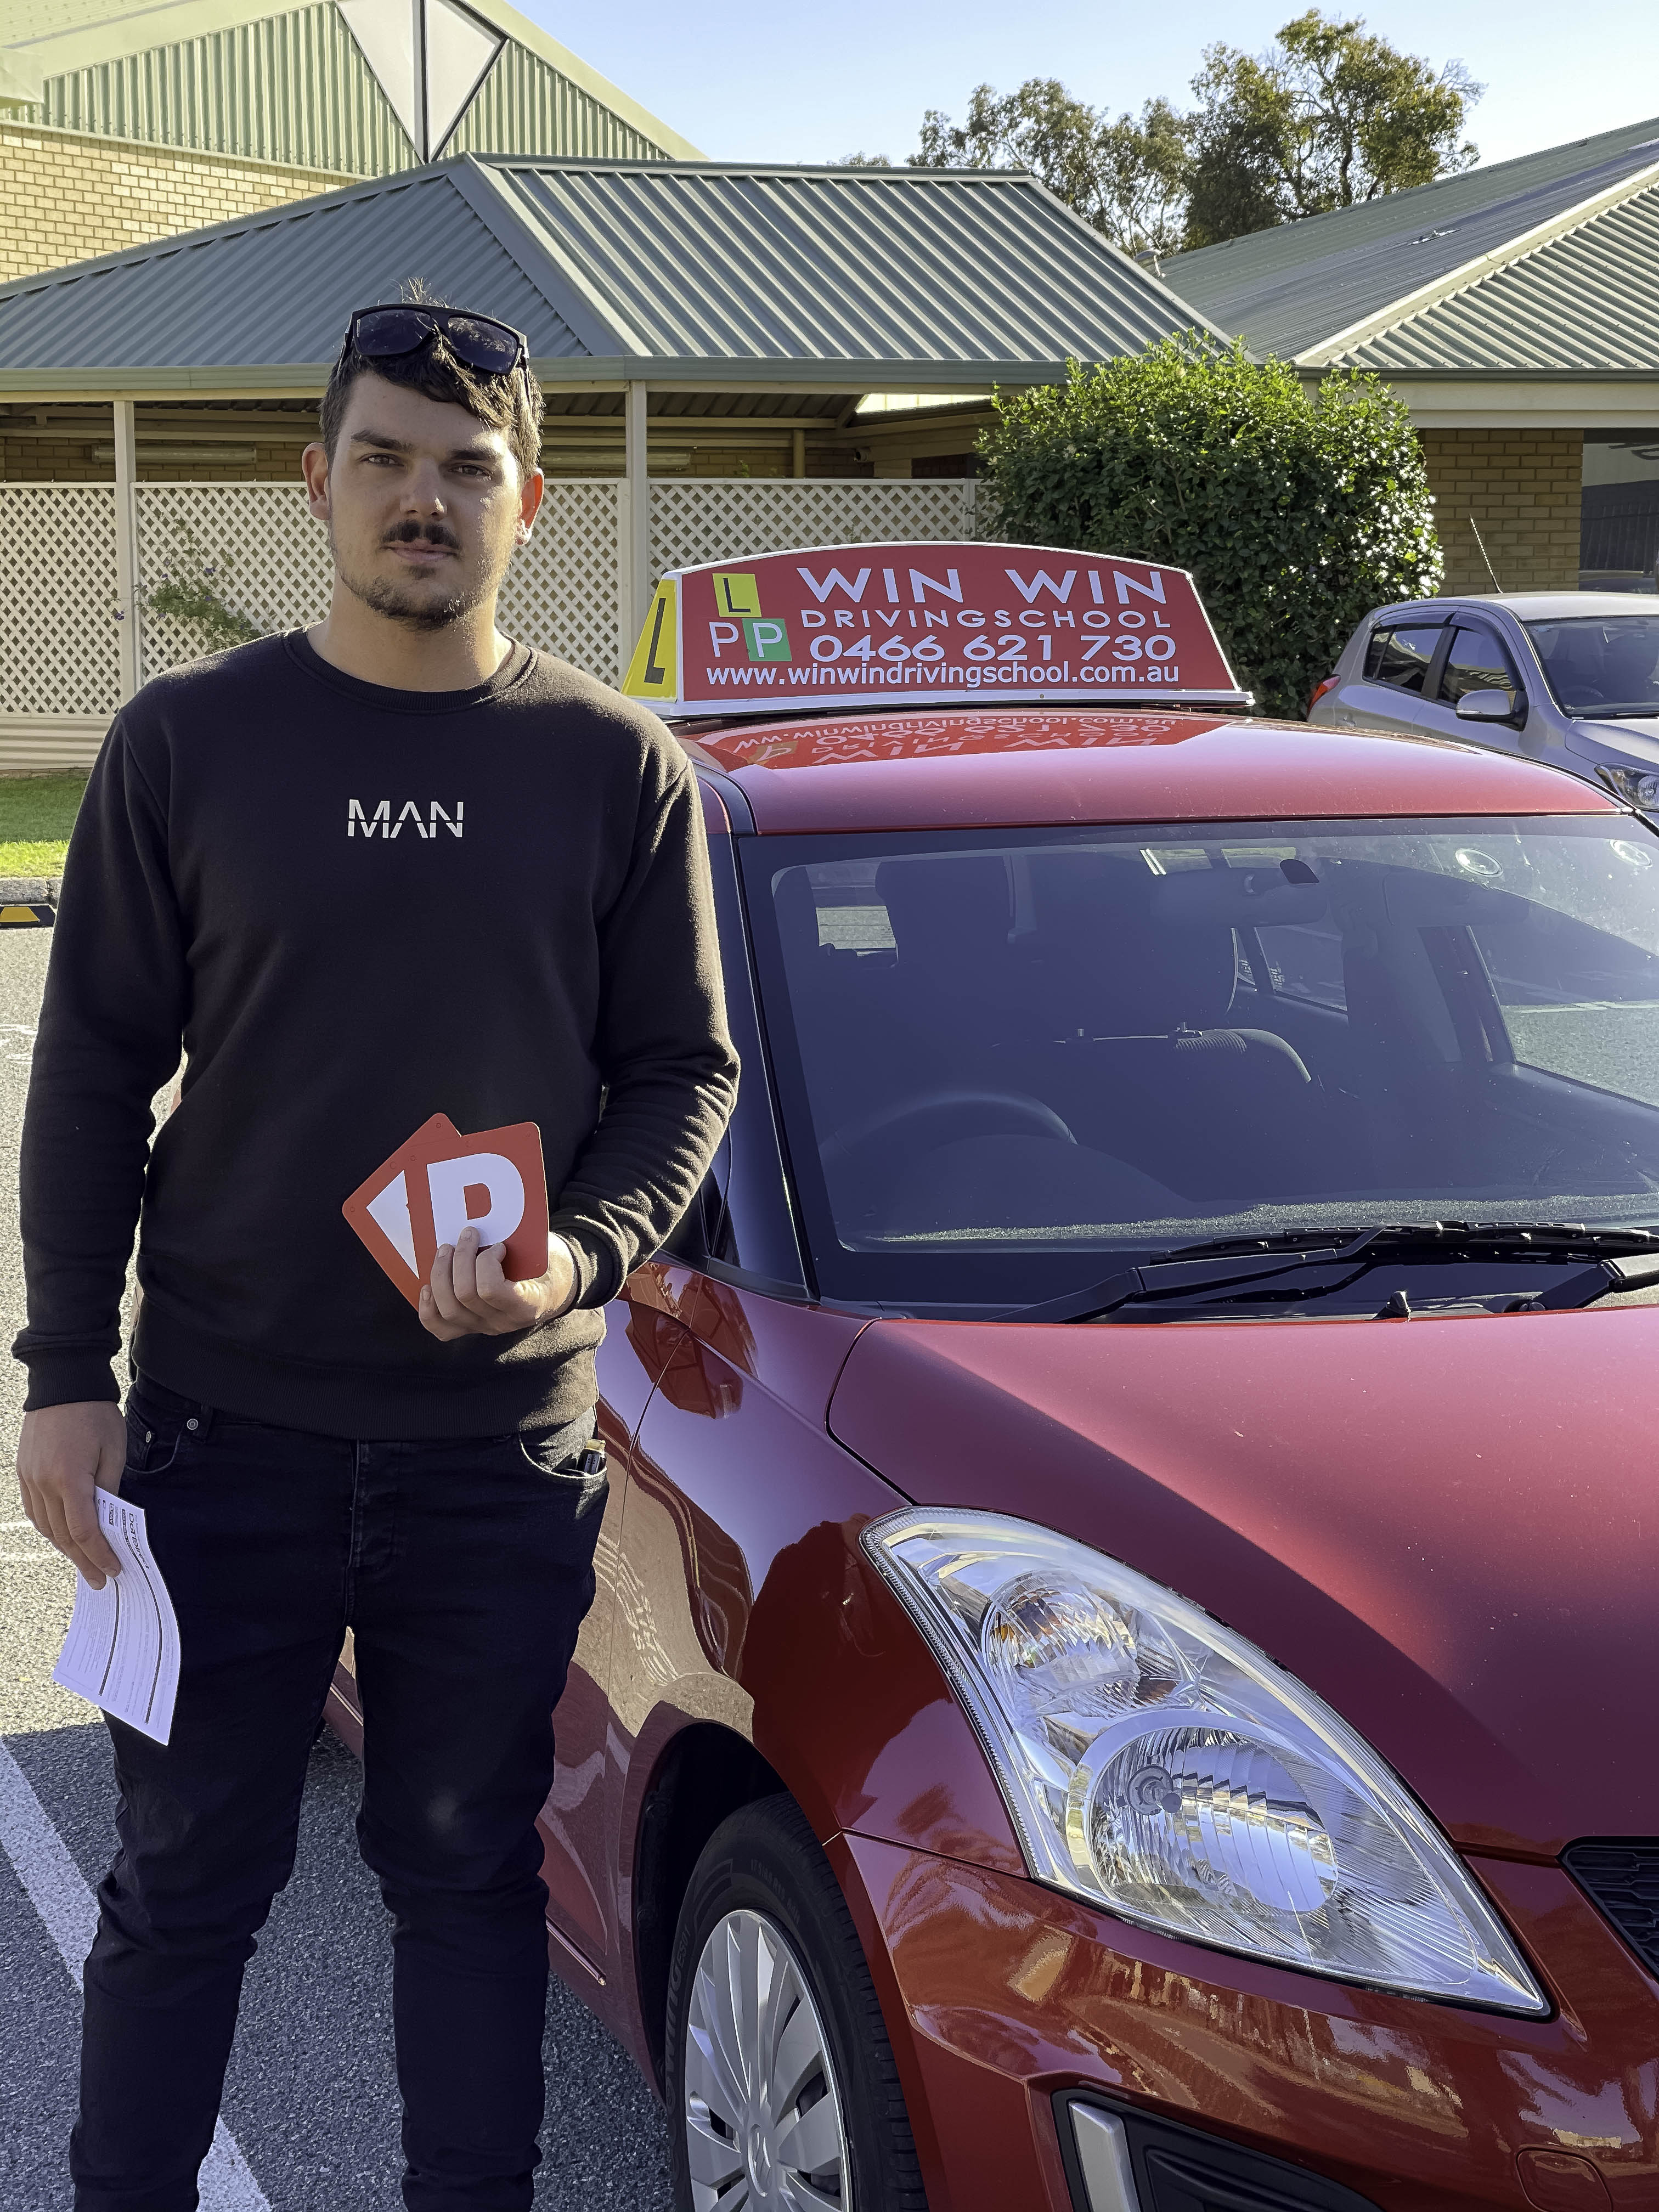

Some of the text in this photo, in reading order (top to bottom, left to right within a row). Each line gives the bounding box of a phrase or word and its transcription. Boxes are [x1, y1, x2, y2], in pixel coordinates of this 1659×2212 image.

[723, 578, 751, 613] L
[797, 567, 1166, 604] WIN WIN
[644, 597, 667, 685] L
[709, 622, 782, 658] P P
[810, 634, 1176, 662] 0466 621 730
[706, 661, 1179, 688] www.winwindrivingschool.com.au
[347, 799, 464, 838] MAN
